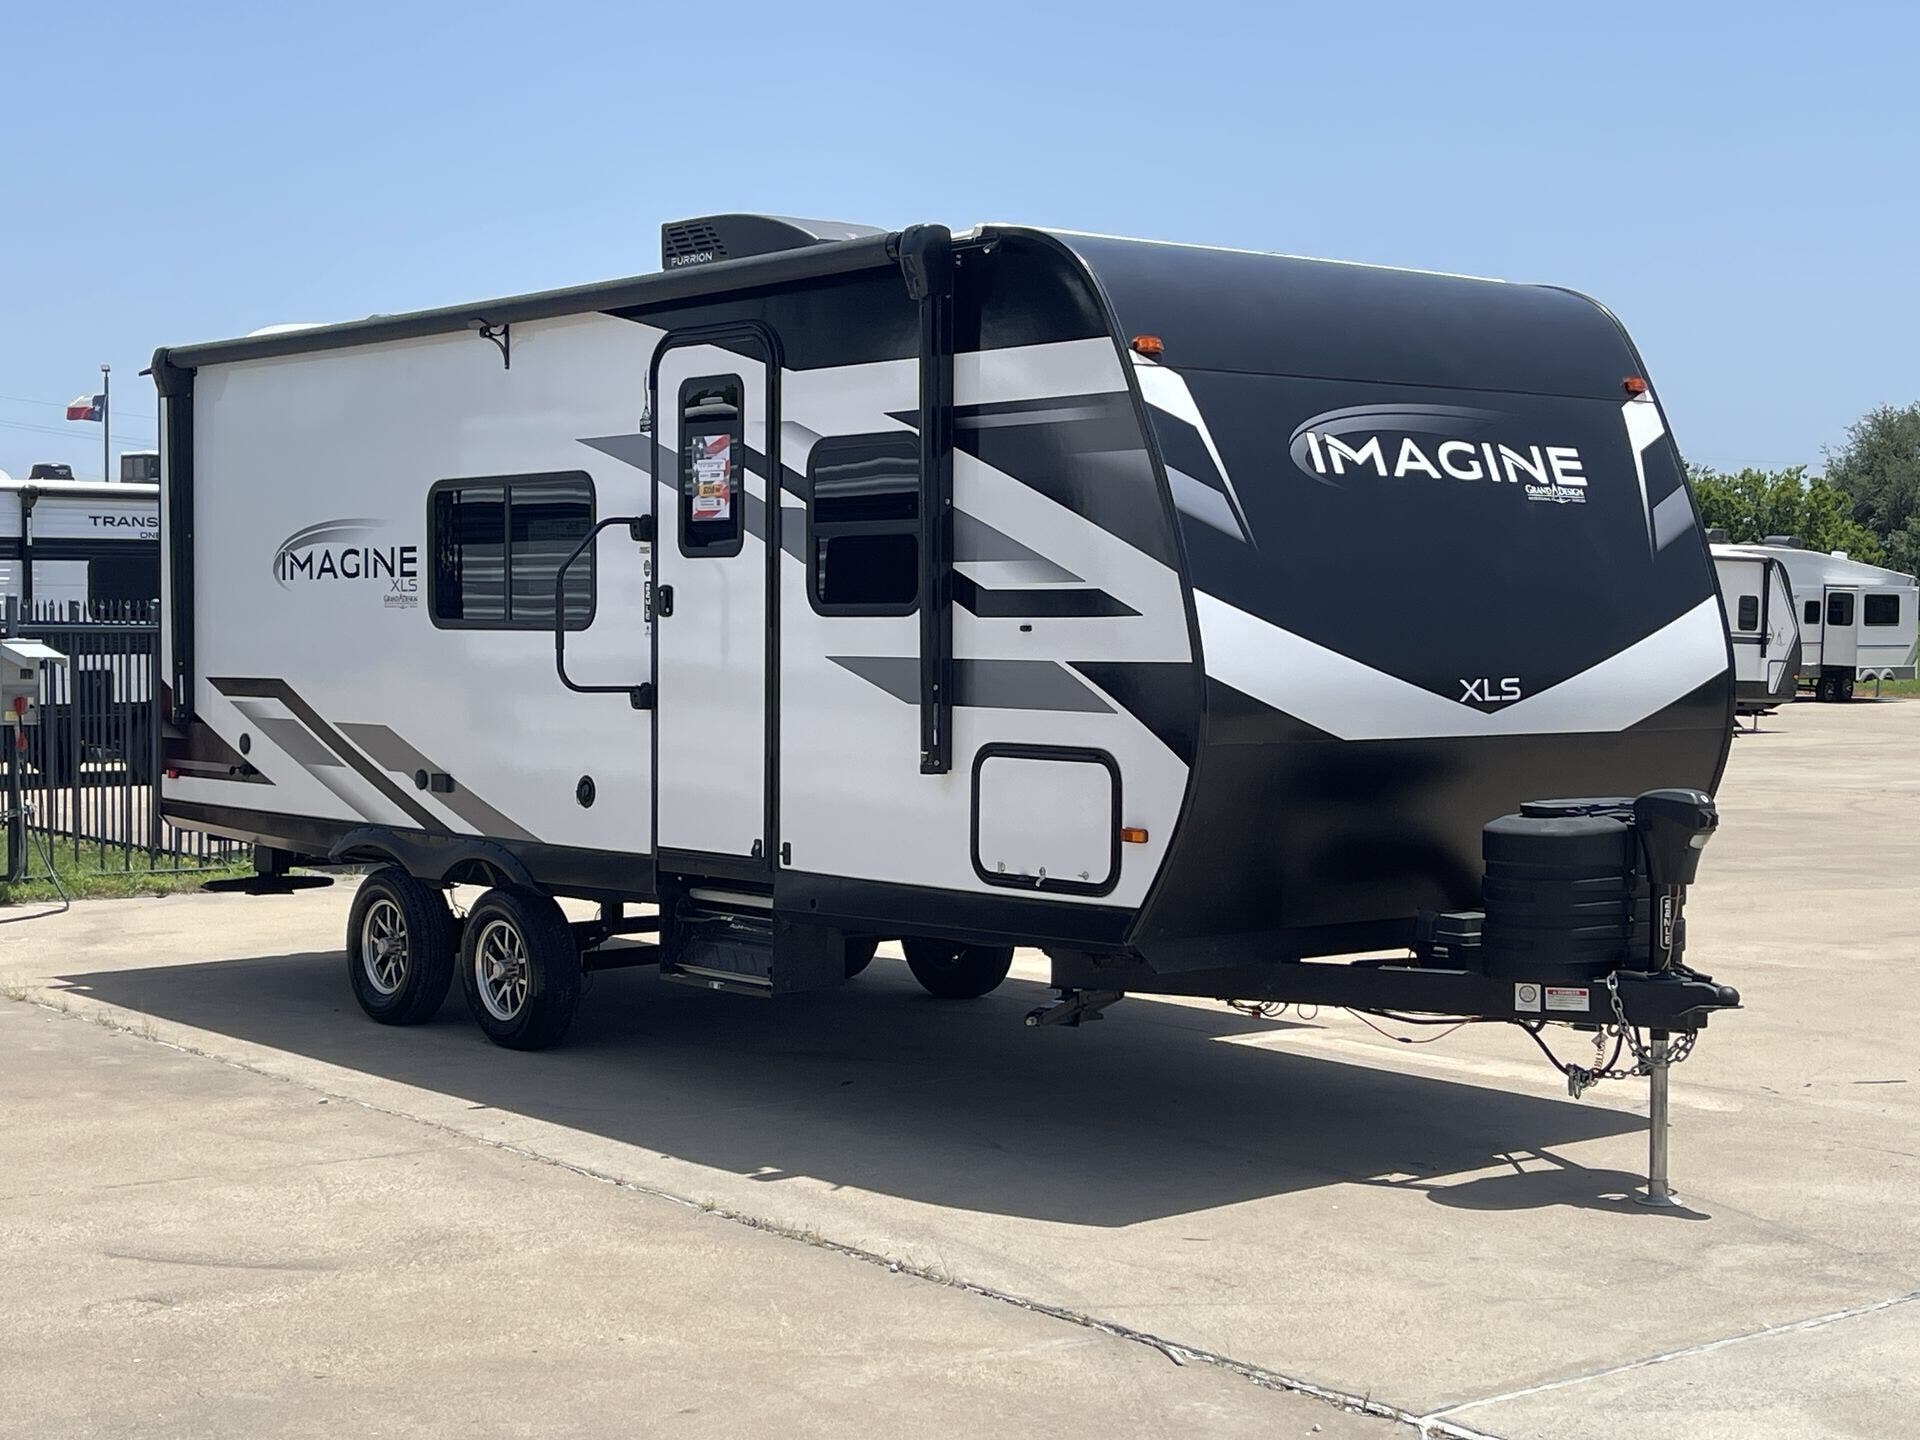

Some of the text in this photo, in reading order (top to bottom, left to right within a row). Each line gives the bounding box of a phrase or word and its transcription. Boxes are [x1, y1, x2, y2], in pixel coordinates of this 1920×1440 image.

[671, 251, 713, 267] FURRION
[1306, 432, 1588, 486] IMAGINE
[1525, 484, 1584, 496] GRAND DESIGN
[88, 515, 159, 528] TRANS
[281, 546, 418, 581] IMAGINE
[390, 578, 418, 592] XLS
[1459, 677, 1522, 702] XLS
